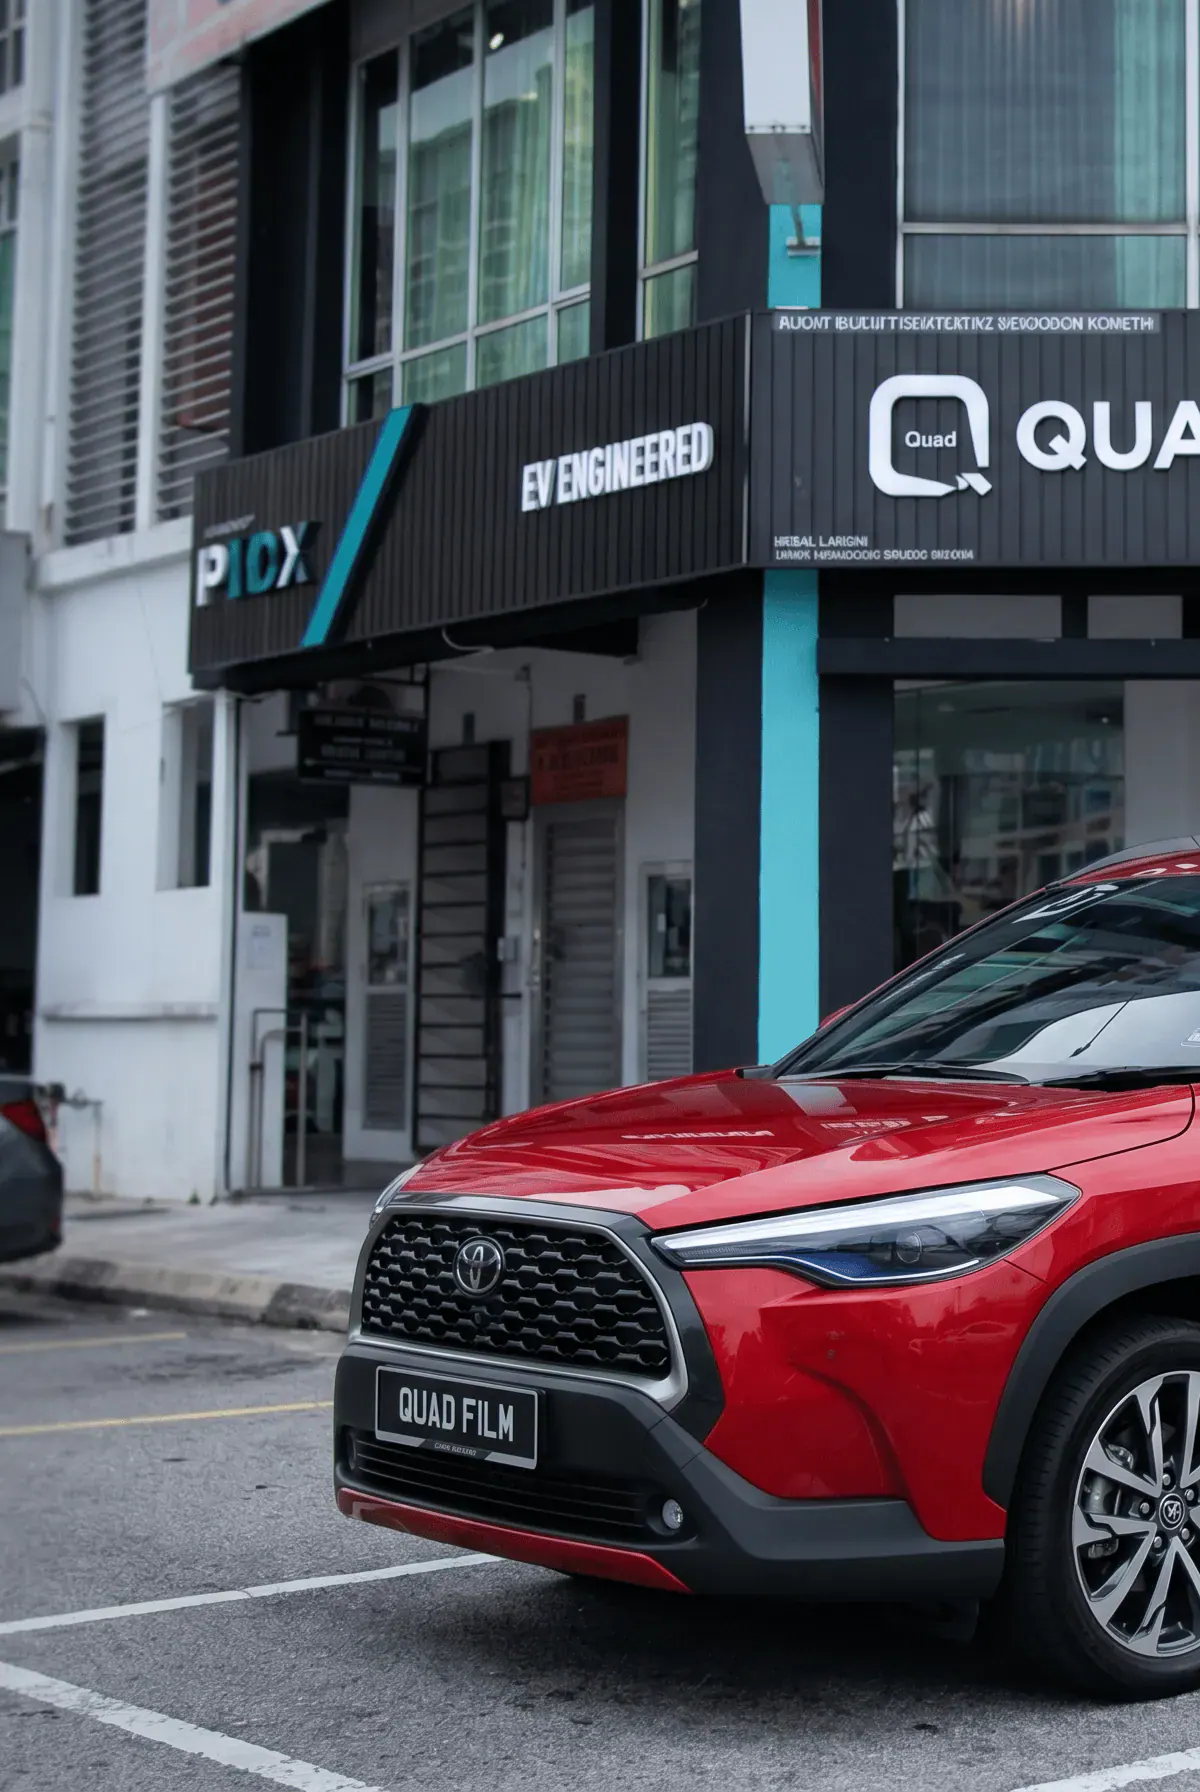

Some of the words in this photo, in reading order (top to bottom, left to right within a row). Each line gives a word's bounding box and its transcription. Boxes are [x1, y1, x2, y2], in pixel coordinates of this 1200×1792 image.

[522, 459, 557, 512] EV
[556, 421, 714, 504] ENGINEERED
[904, 431, 957, 449] Quad
[399, 1386, 456, 1431] QUAD
[462, 1396, 514, 1442] FILM
